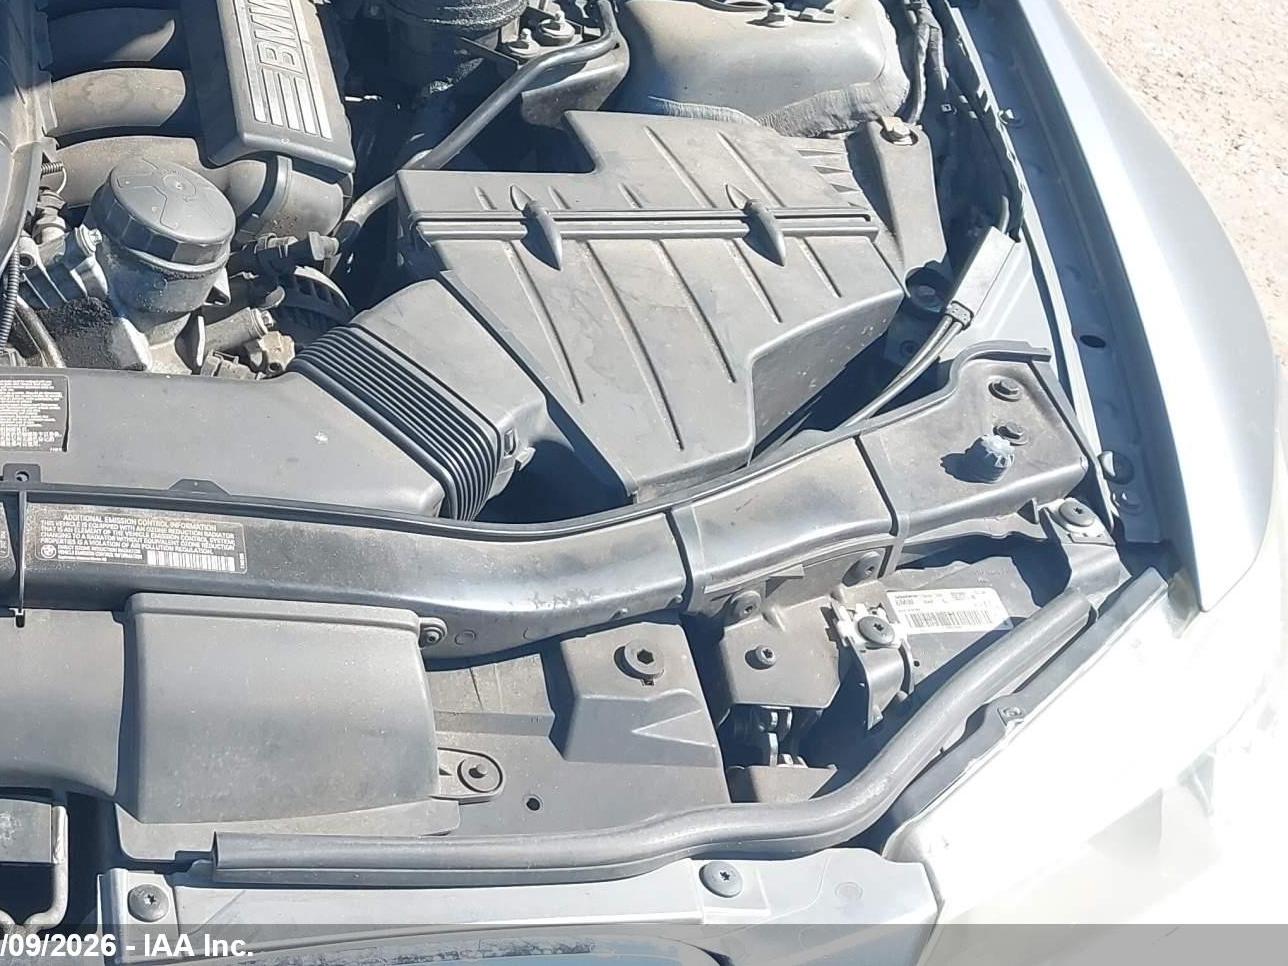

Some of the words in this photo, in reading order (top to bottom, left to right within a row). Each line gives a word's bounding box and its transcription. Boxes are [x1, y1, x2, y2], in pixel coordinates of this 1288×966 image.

[63, 514, 103, 523] ADDITIONAL
[104, 516, 136, 525] EMISSION
[138, 518, 169, 527] CONTROL
[169, 521, 216, 531] INFORMATION
[87, 533, 115, 541] RADIATOR
[144, 538, 179, 546] EQUIVALENT
[201, 542, 234, 550] REDUCTION
[168, 528, 203, 536] REDUCTION
[204, 531, 234, 539] RADIATOR
